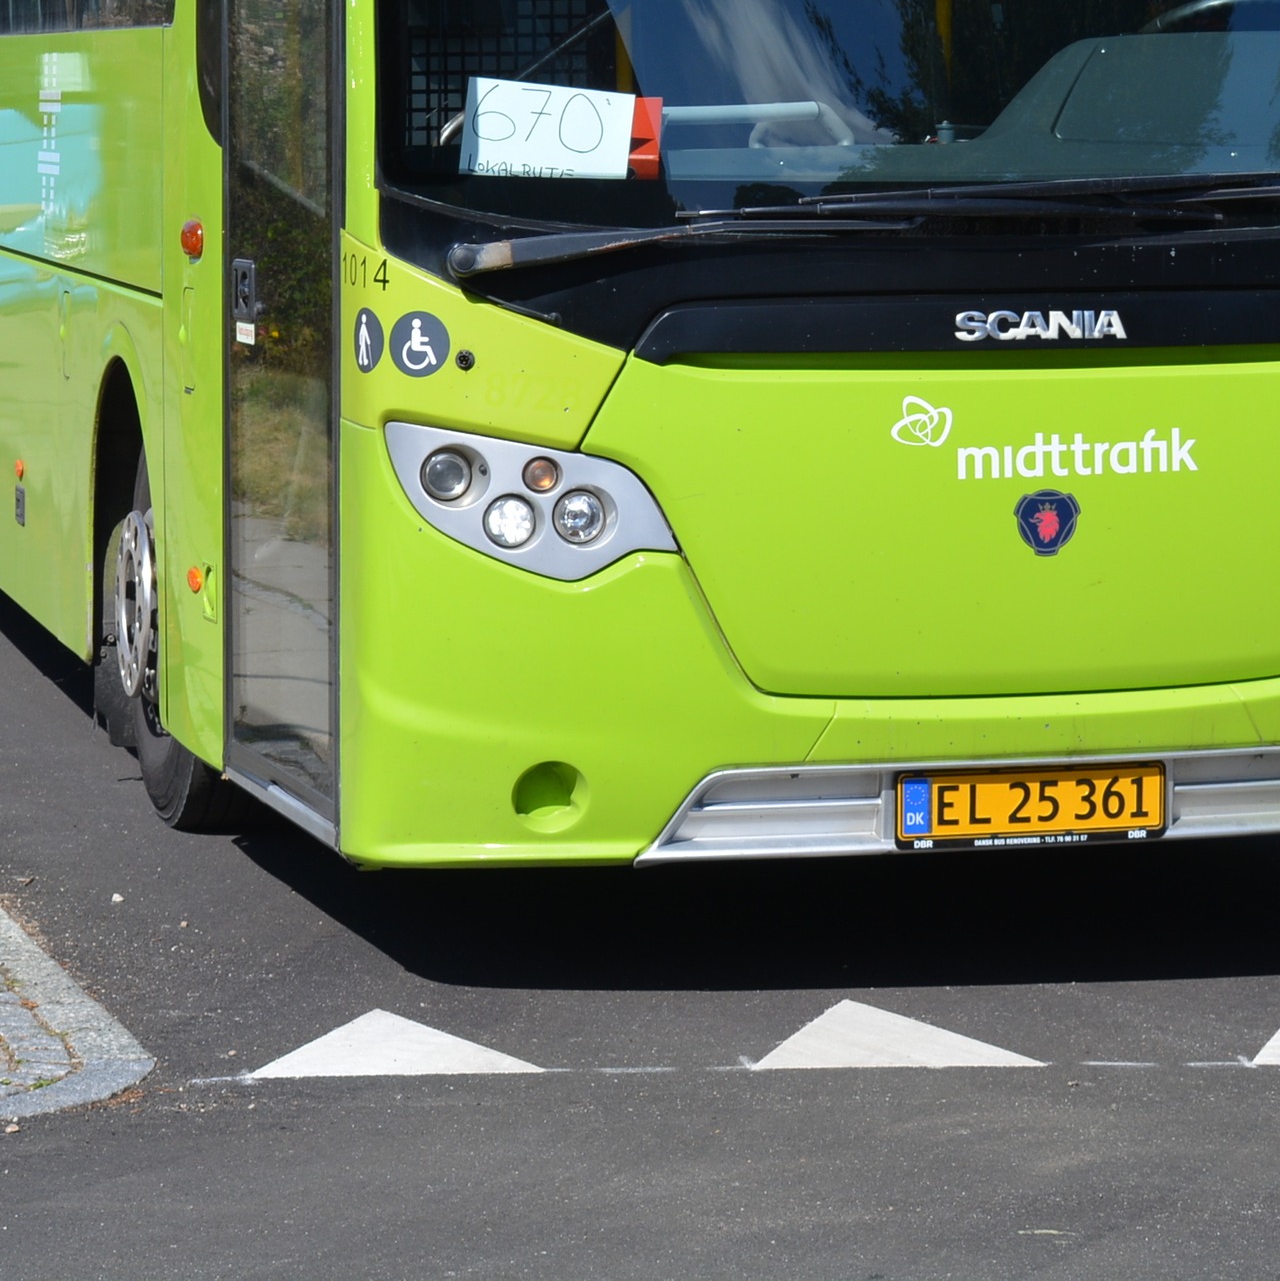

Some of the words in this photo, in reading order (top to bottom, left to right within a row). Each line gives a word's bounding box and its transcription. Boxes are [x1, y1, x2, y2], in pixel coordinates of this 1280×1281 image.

[472, 84, 603, 153] 670
[342, 251, 390, 291] 1014
[954, 309, 1128, 341] SCANIA
[956, 426, 1199, 480] midttrafik
[937, 783, 992, 826] EL
[1008, 779, 1060, 824] 25
[1074, 775, 1150, 821] 361
[906, 812, 925, 826] DK
[1128, 830, 1147, 839] DBR
[913, 840, 934, 849] DBR
